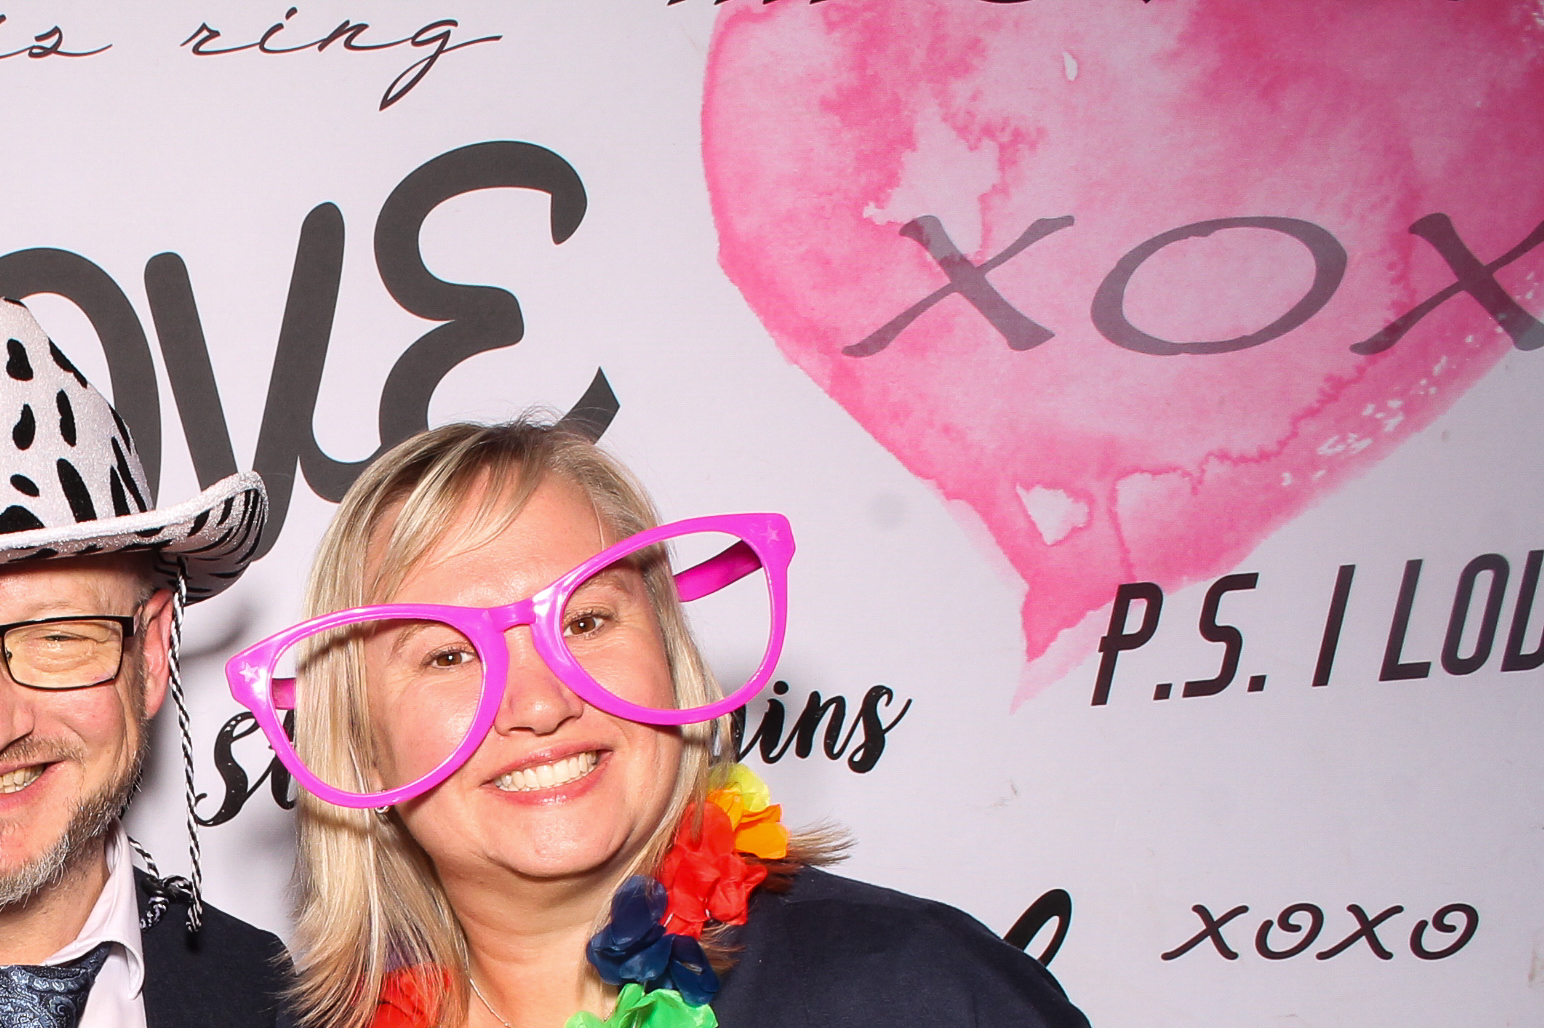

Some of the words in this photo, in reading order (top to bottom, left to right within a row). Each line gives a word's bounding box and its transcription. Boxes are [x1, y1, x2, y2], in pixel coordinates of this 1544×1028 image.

[181, 7, 502, 110] ring
[1092, 573, 1266, 706] P.S.
[1312, 565, 1355, 686] I
